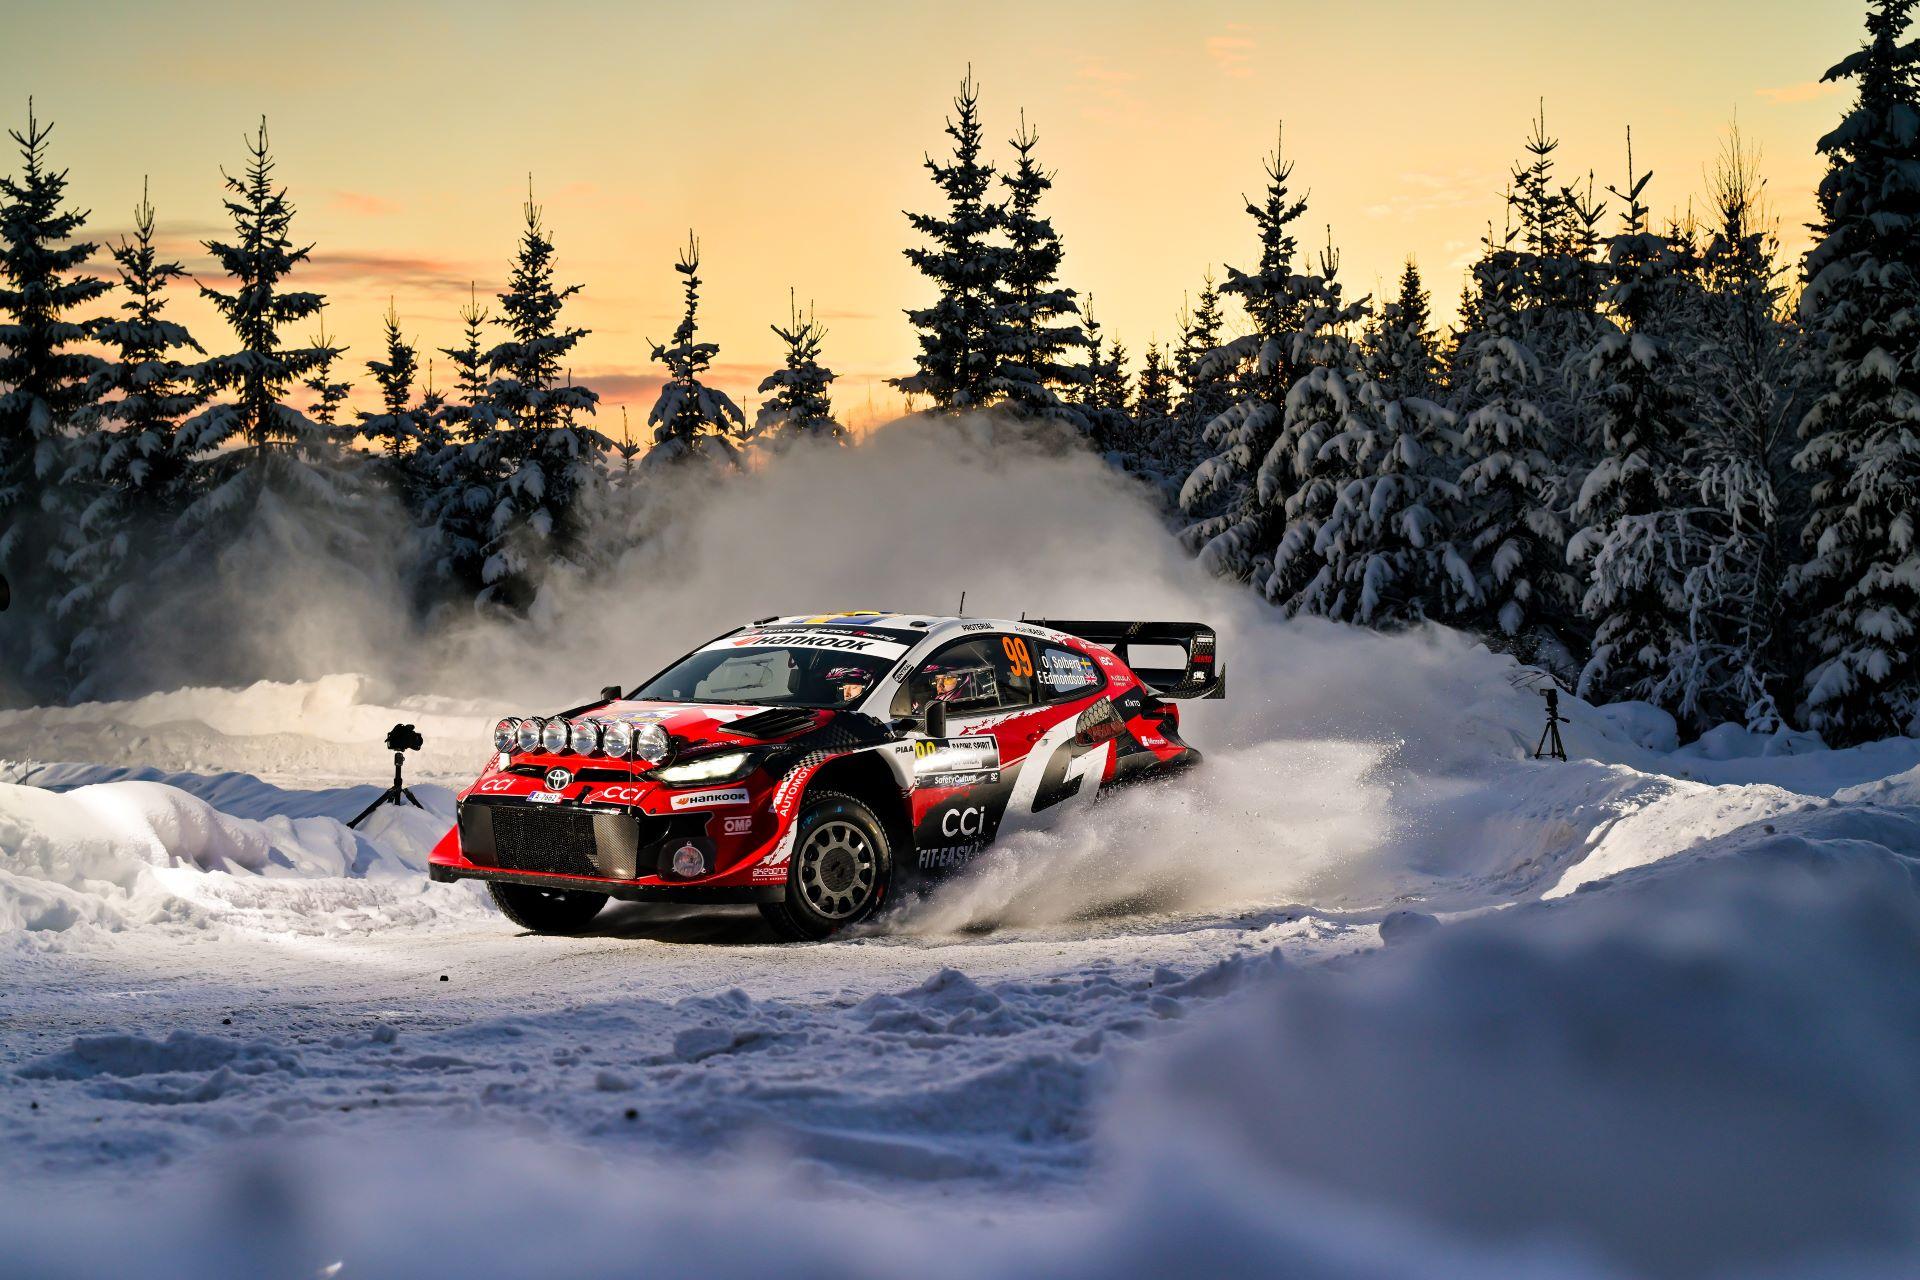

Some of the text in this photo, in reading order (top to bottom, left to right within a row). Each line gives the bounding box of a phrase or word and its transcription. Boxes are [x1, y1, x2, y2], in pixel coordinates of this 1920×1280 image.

[961, 622, 995, 632] PROTERIAL
[1002, 636, 1033, 677] 99
[1052, 656, 1082, 672] Solberg
[895, 745, 914, 754] PIAA
[723, 820, 752, 832] OMP
